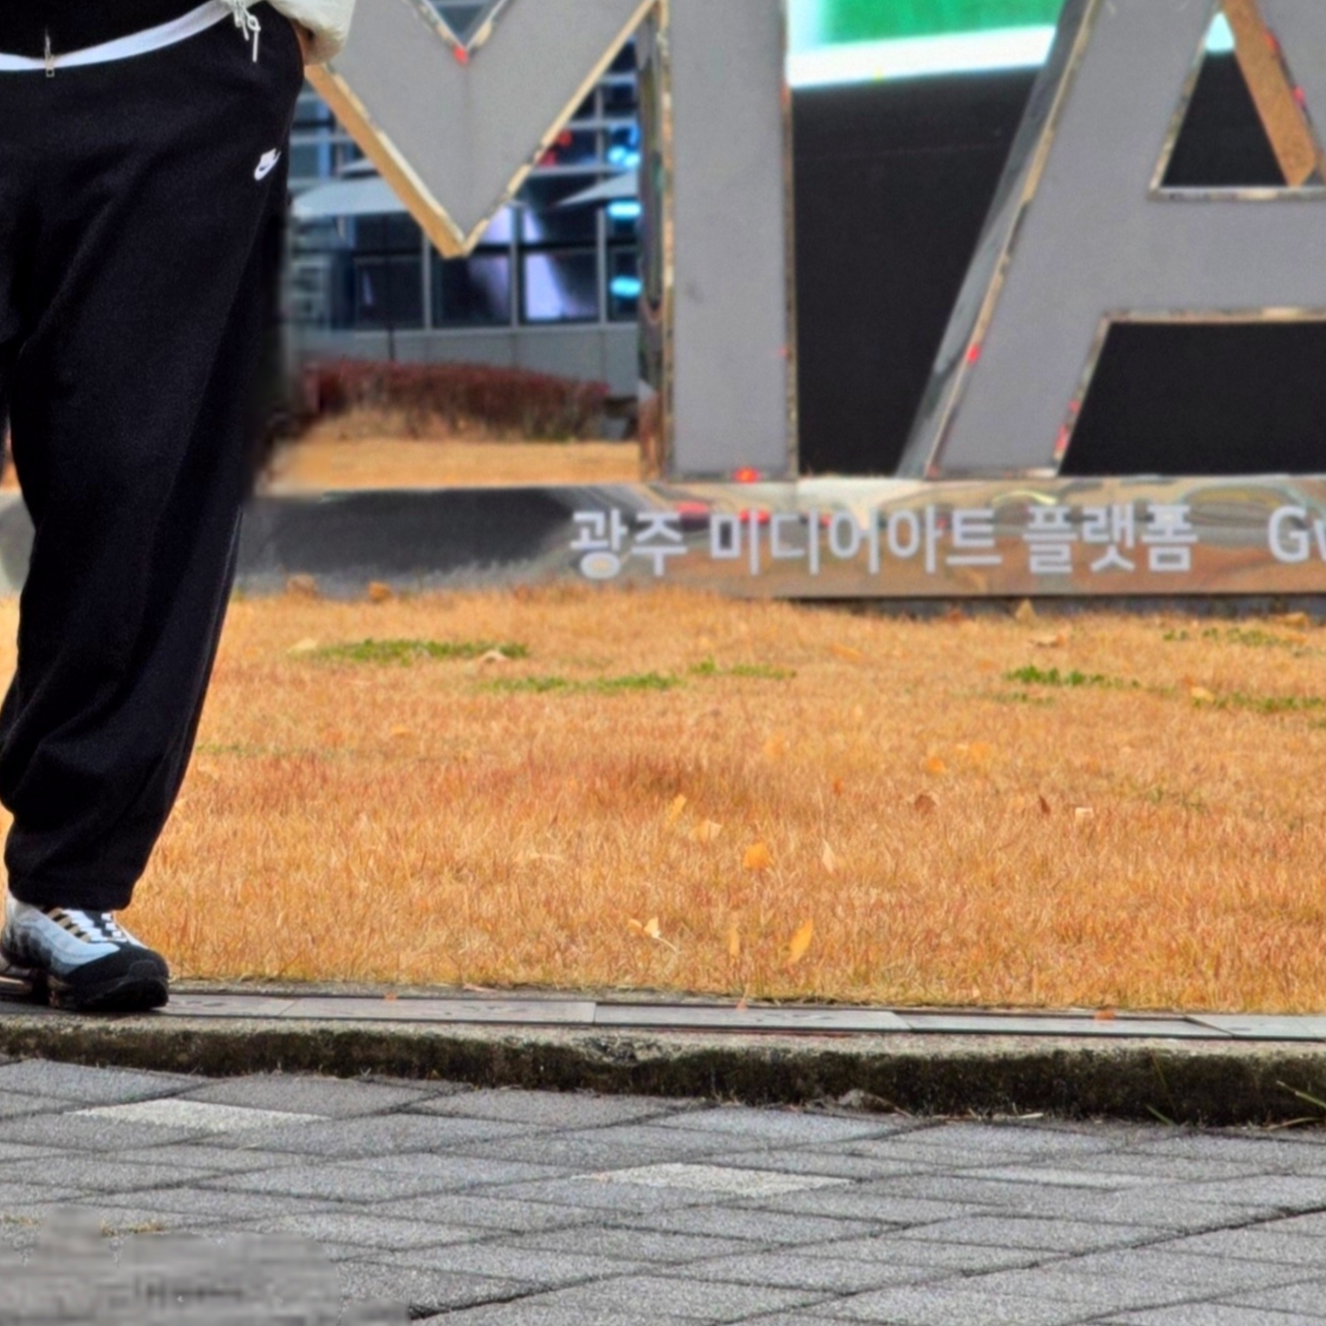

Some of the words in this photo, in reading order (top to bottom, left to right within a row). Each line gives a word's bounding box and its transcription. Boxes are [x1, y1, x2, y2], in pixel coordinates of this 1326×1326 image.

[570, 508, 687, 579] 광주
[710, 506, 1002, 575] 미디어아트
[1023, 504, 1198, 573] 플랫폼
